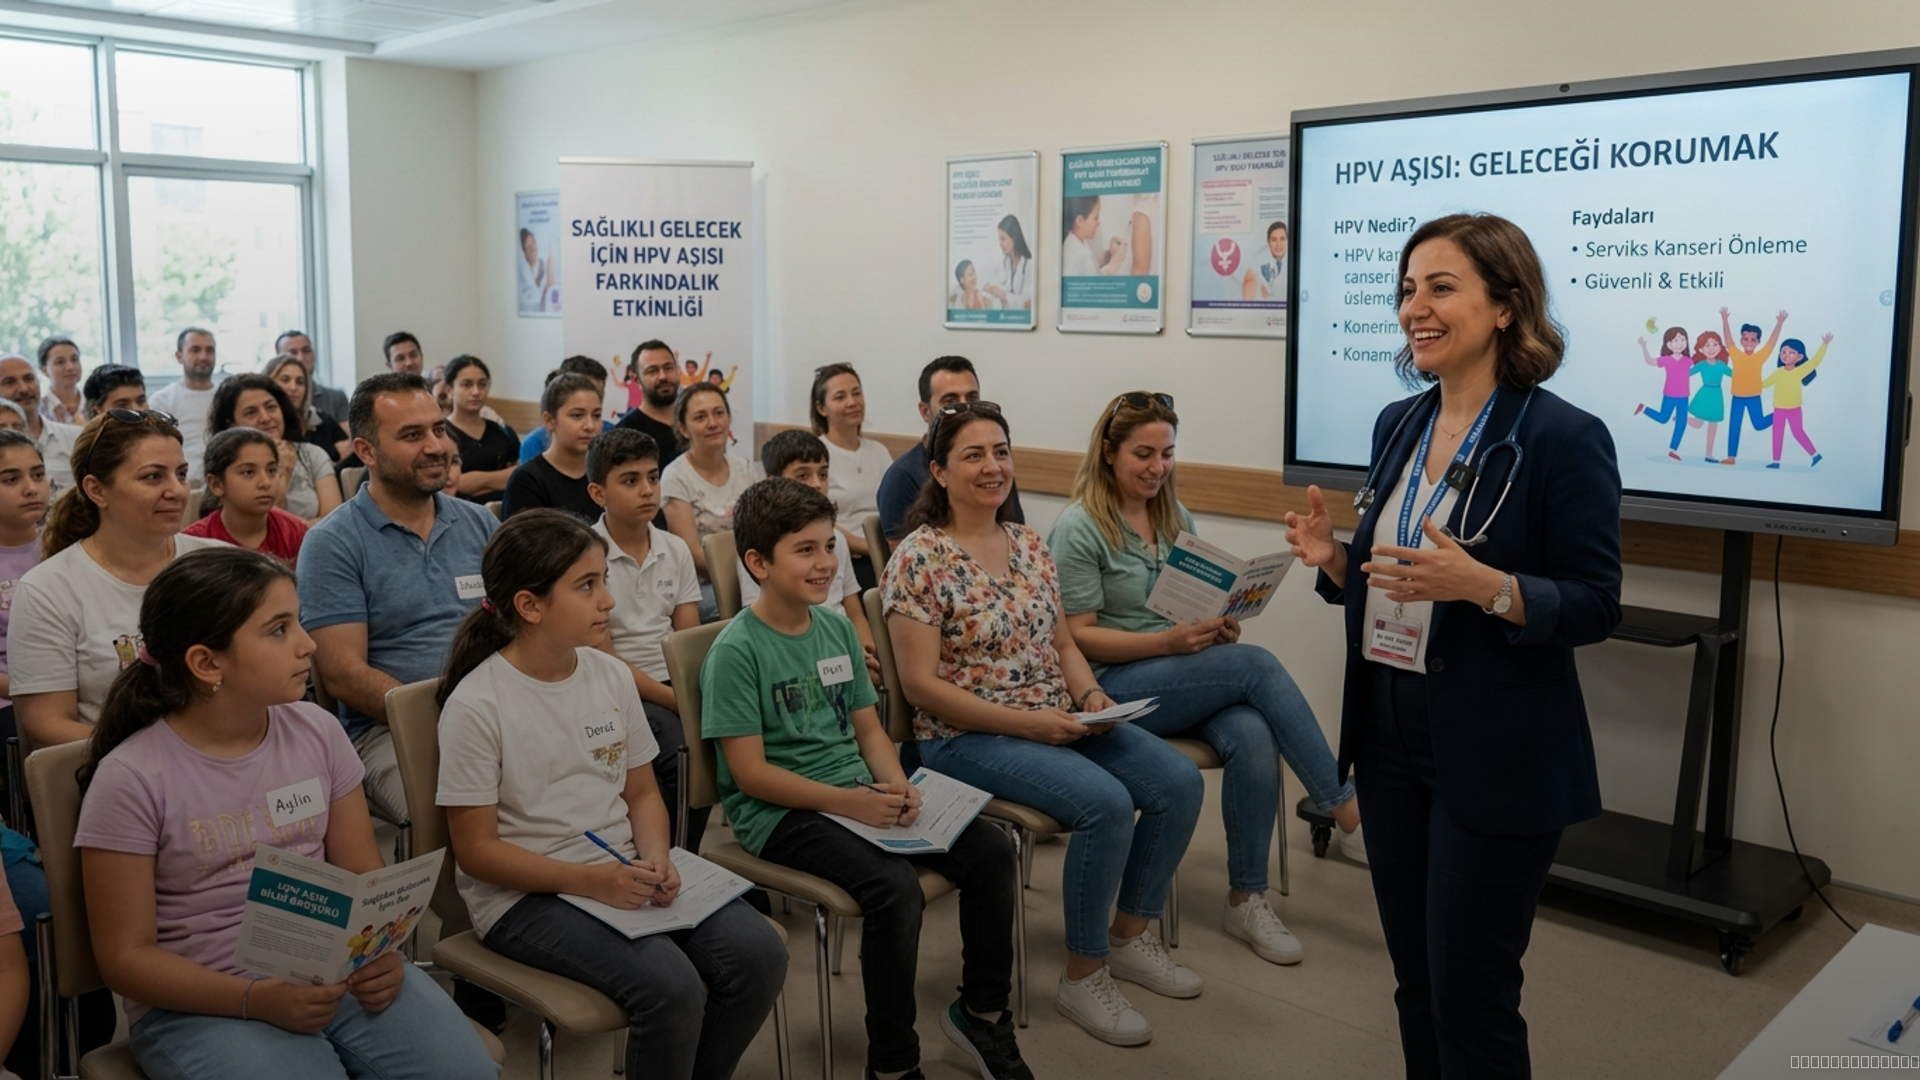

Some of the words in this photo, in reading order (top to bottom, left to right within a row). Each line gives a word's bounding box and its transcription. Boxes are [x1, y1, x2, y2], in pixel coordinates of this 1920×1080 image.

[1335, 159, 1384, 185] HPV
[1390, 154, 1460, 187] AŞISI:
[1469, 137, 1600, 177] GELECEĞİ
[1610, 131, 1780, 169] KORUMAK
[571, 216, 655, 238] SAĞLIKLI
[660, 220, 742, 239] GELECEK
[1334, 219, 1364, 235] HPV
[1367, 216, 1417, 233] Nedir?
[1572, 207, 1654, 229] Faydaları
[590, 242, 628, 267] İÇİN
[634, 247, 671, 264] HPV
[676, 247, 724, 267] AŞISI
[1344, 248, 1374, 263] HPV
[1585, 239, 1649, 258] Serviks
[1654, 238, 1723, 257] Kanseri
[1728, 233, 1808, 255] Önleme
[596, 273, 720, 291] FARKINDALIK
[1585, 272, 1652, 290] Güvenli
[1658, 272, 1673, 289] &
[1679, 271, 1724, 289] Etkili
[613, 296, 703, 317] ETKİNLİĞİ
[1343, 347, 1397, 362] Konam
[275, 793, 312, 814] Aylin
